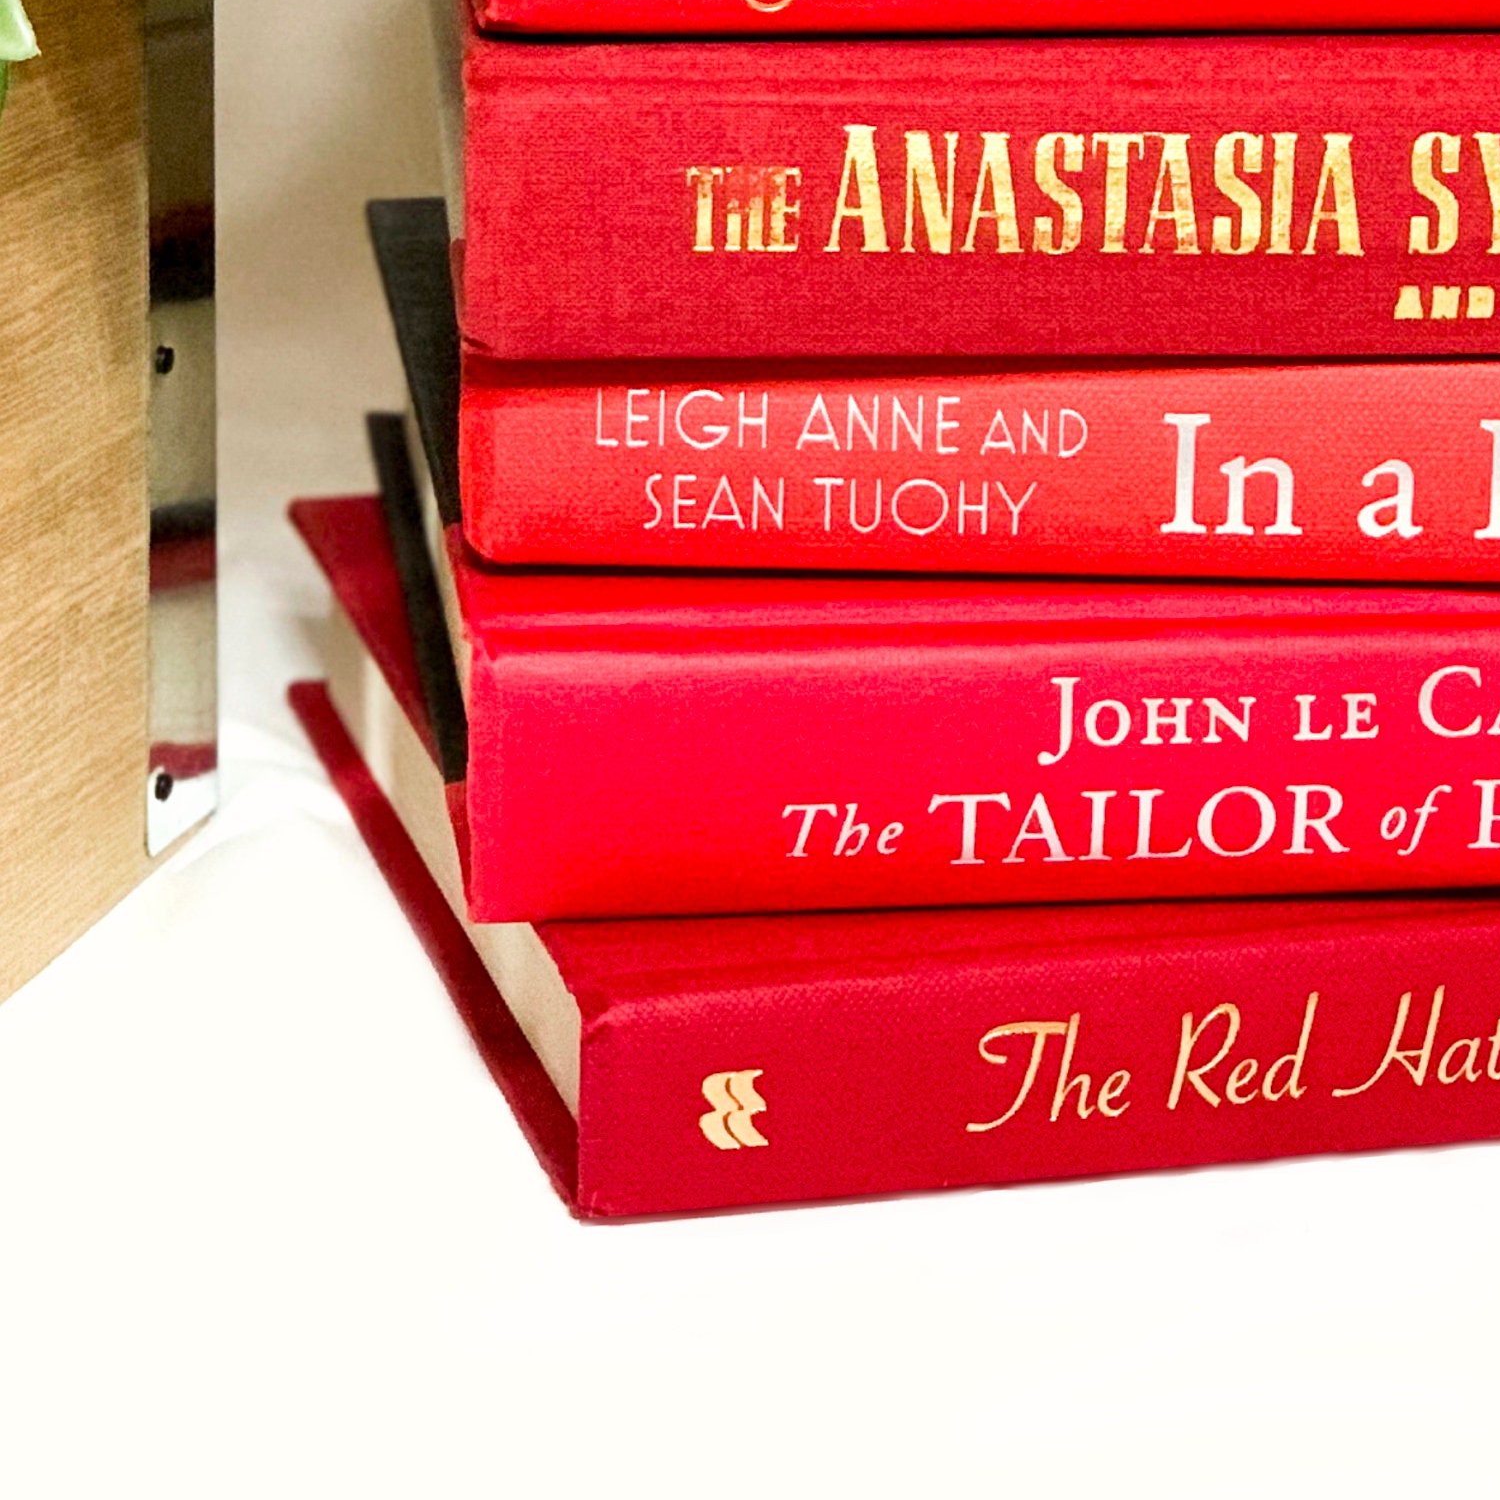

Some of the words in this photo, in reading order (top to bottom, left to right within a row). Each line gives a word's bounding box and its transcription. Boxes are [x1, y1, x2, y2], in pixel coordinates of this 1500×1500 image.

[687, 167, 800, 252] THE
[824, 125, 1364, 256] ANASTASIA
[1394, 286, 1494, 319] AND
[595, 390, 768, 449] LEIGH
[796, 394, 960, 454] ANNE
[981, 409, 1087, 457] AND
[644, 474, 784, 530] SEAN
[813, 478, 1036, 535] TUOHY
[1161, 413, 1302, 535] In
[1358, 460, 1422, 538] a
[1293, 693, 1379, 740] LE
[782, 803, 904, 857] The
[928, 785, 1350, 864] TAILOR
[1381, 784, 1452, 855] of
[966, 1013, 1130, 1132] The
[1167, 992, 1318, 1109] Red
